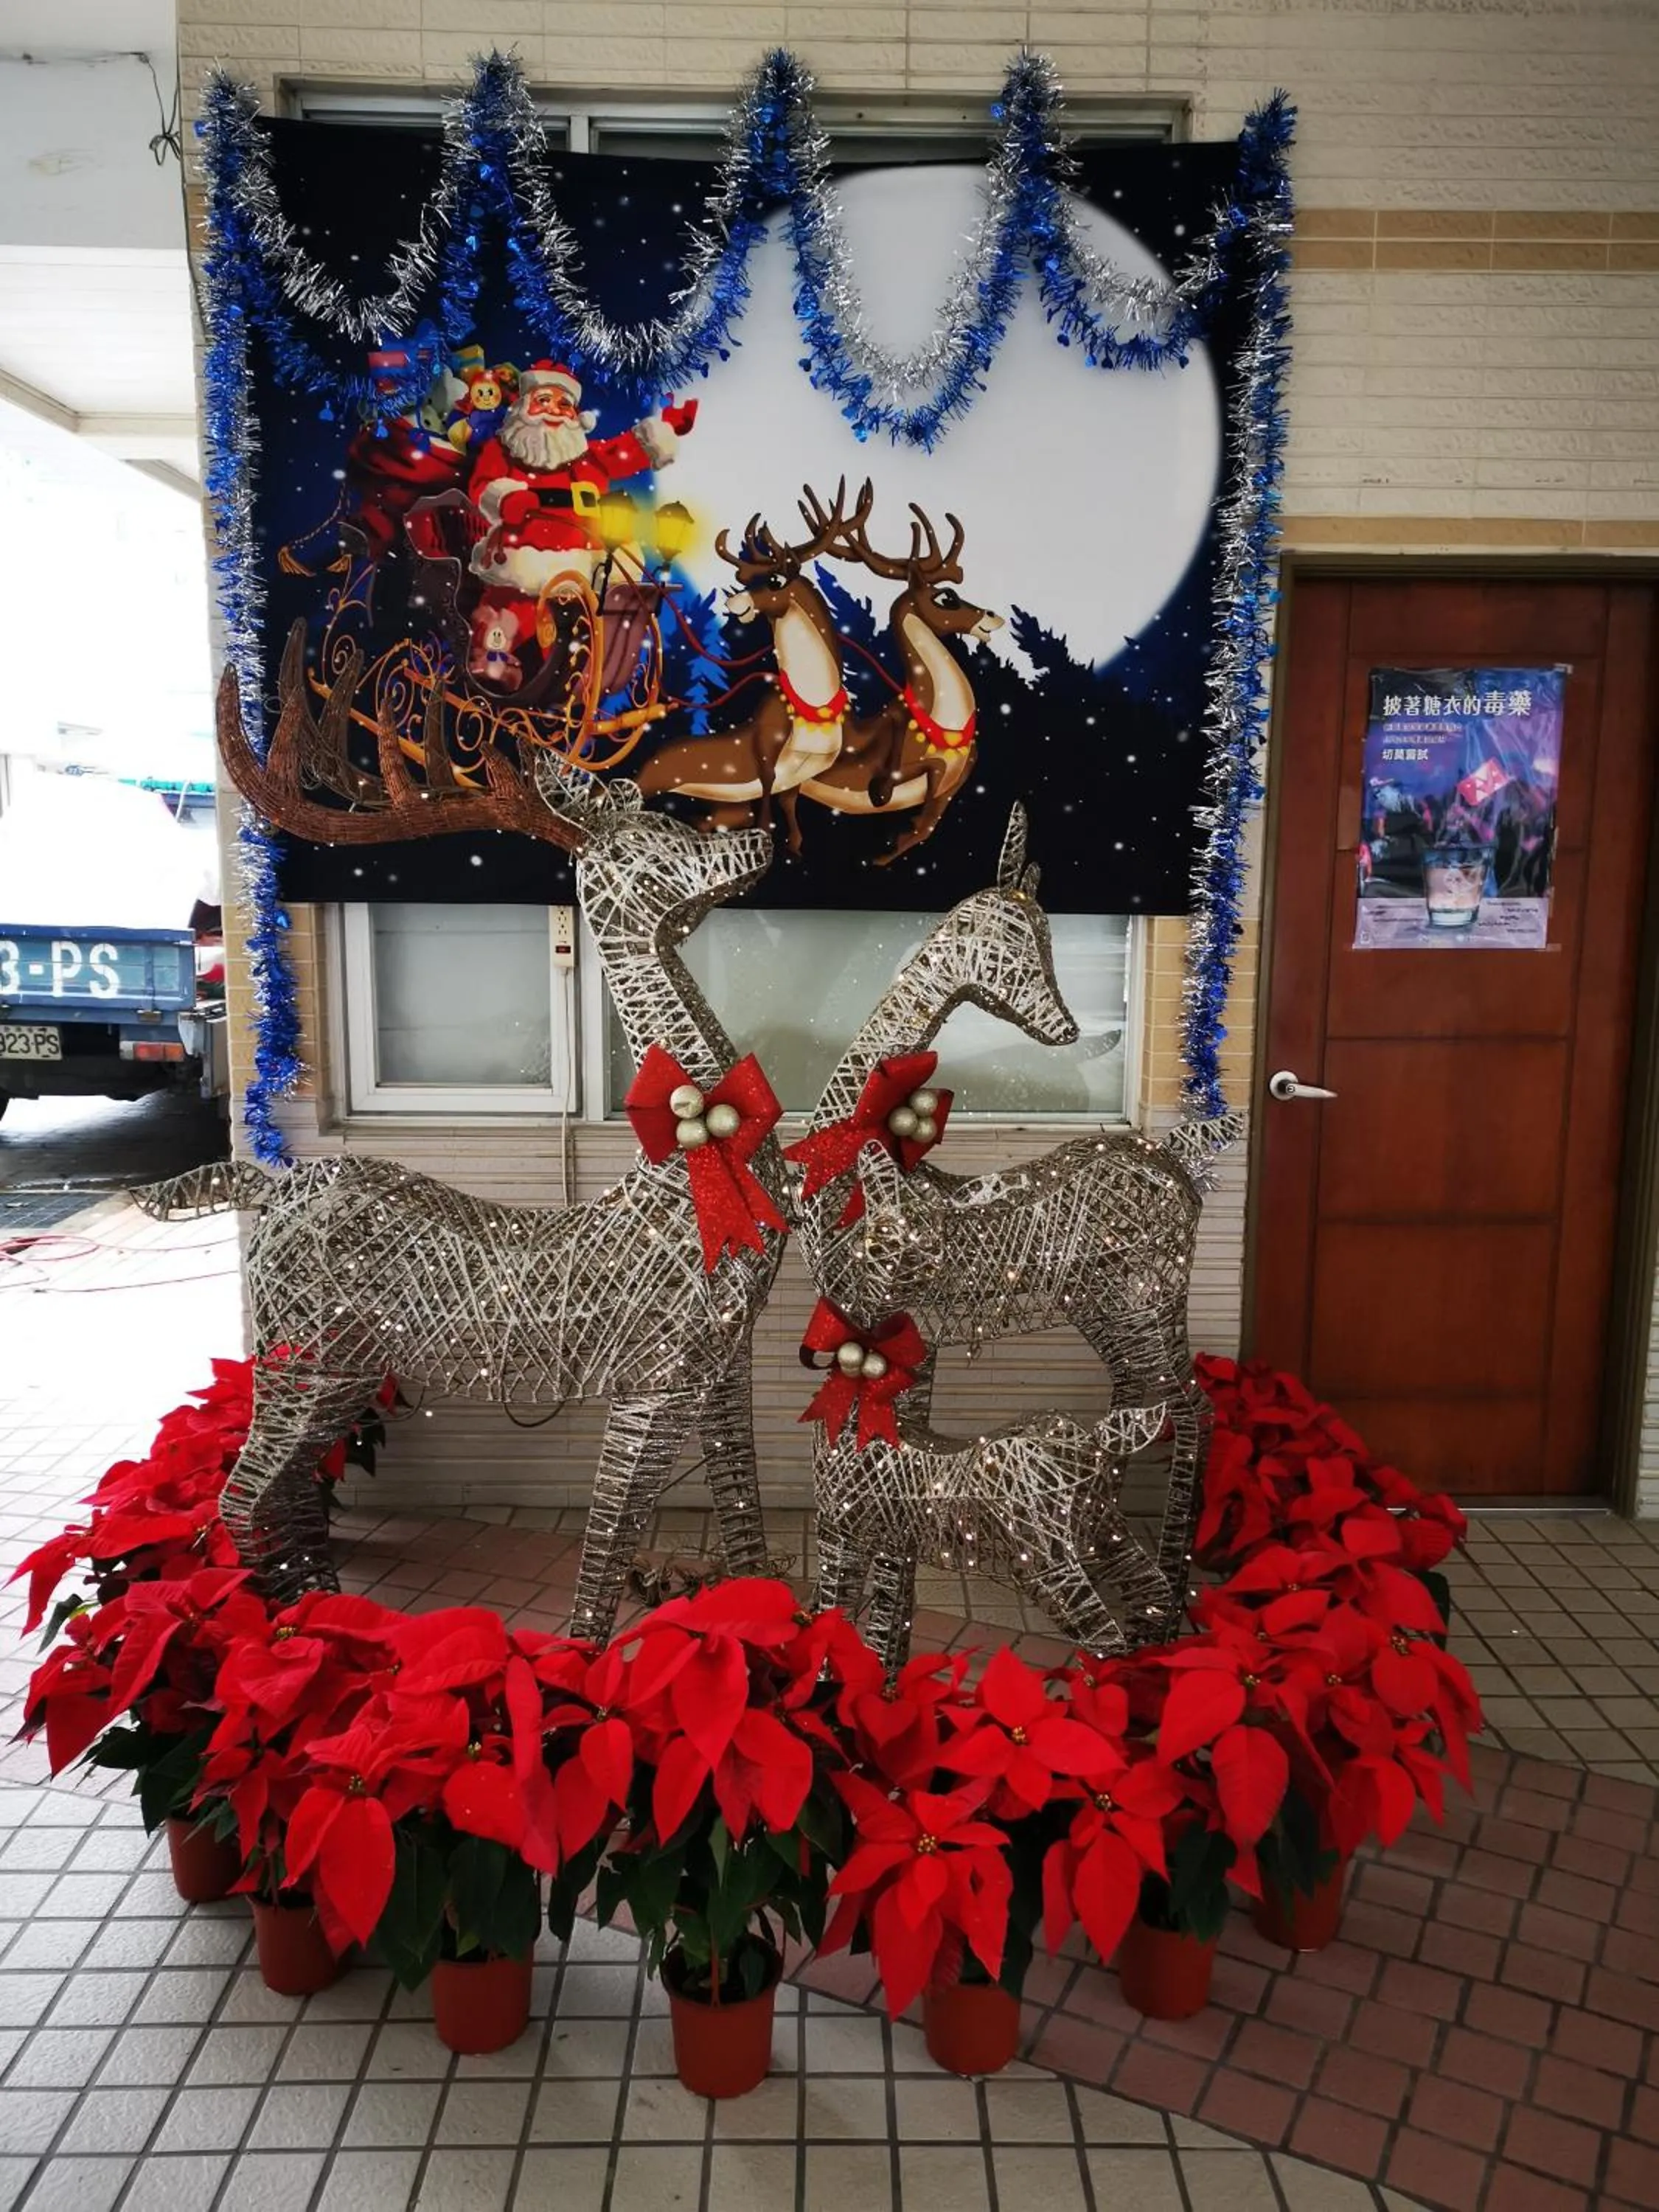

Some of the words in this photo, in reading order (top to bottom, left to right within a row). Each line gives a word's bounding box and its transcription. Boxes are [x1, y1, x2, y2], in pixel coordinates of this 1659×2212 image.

[1382, 690, 1532, 716] 披著糖衣的毒藥
